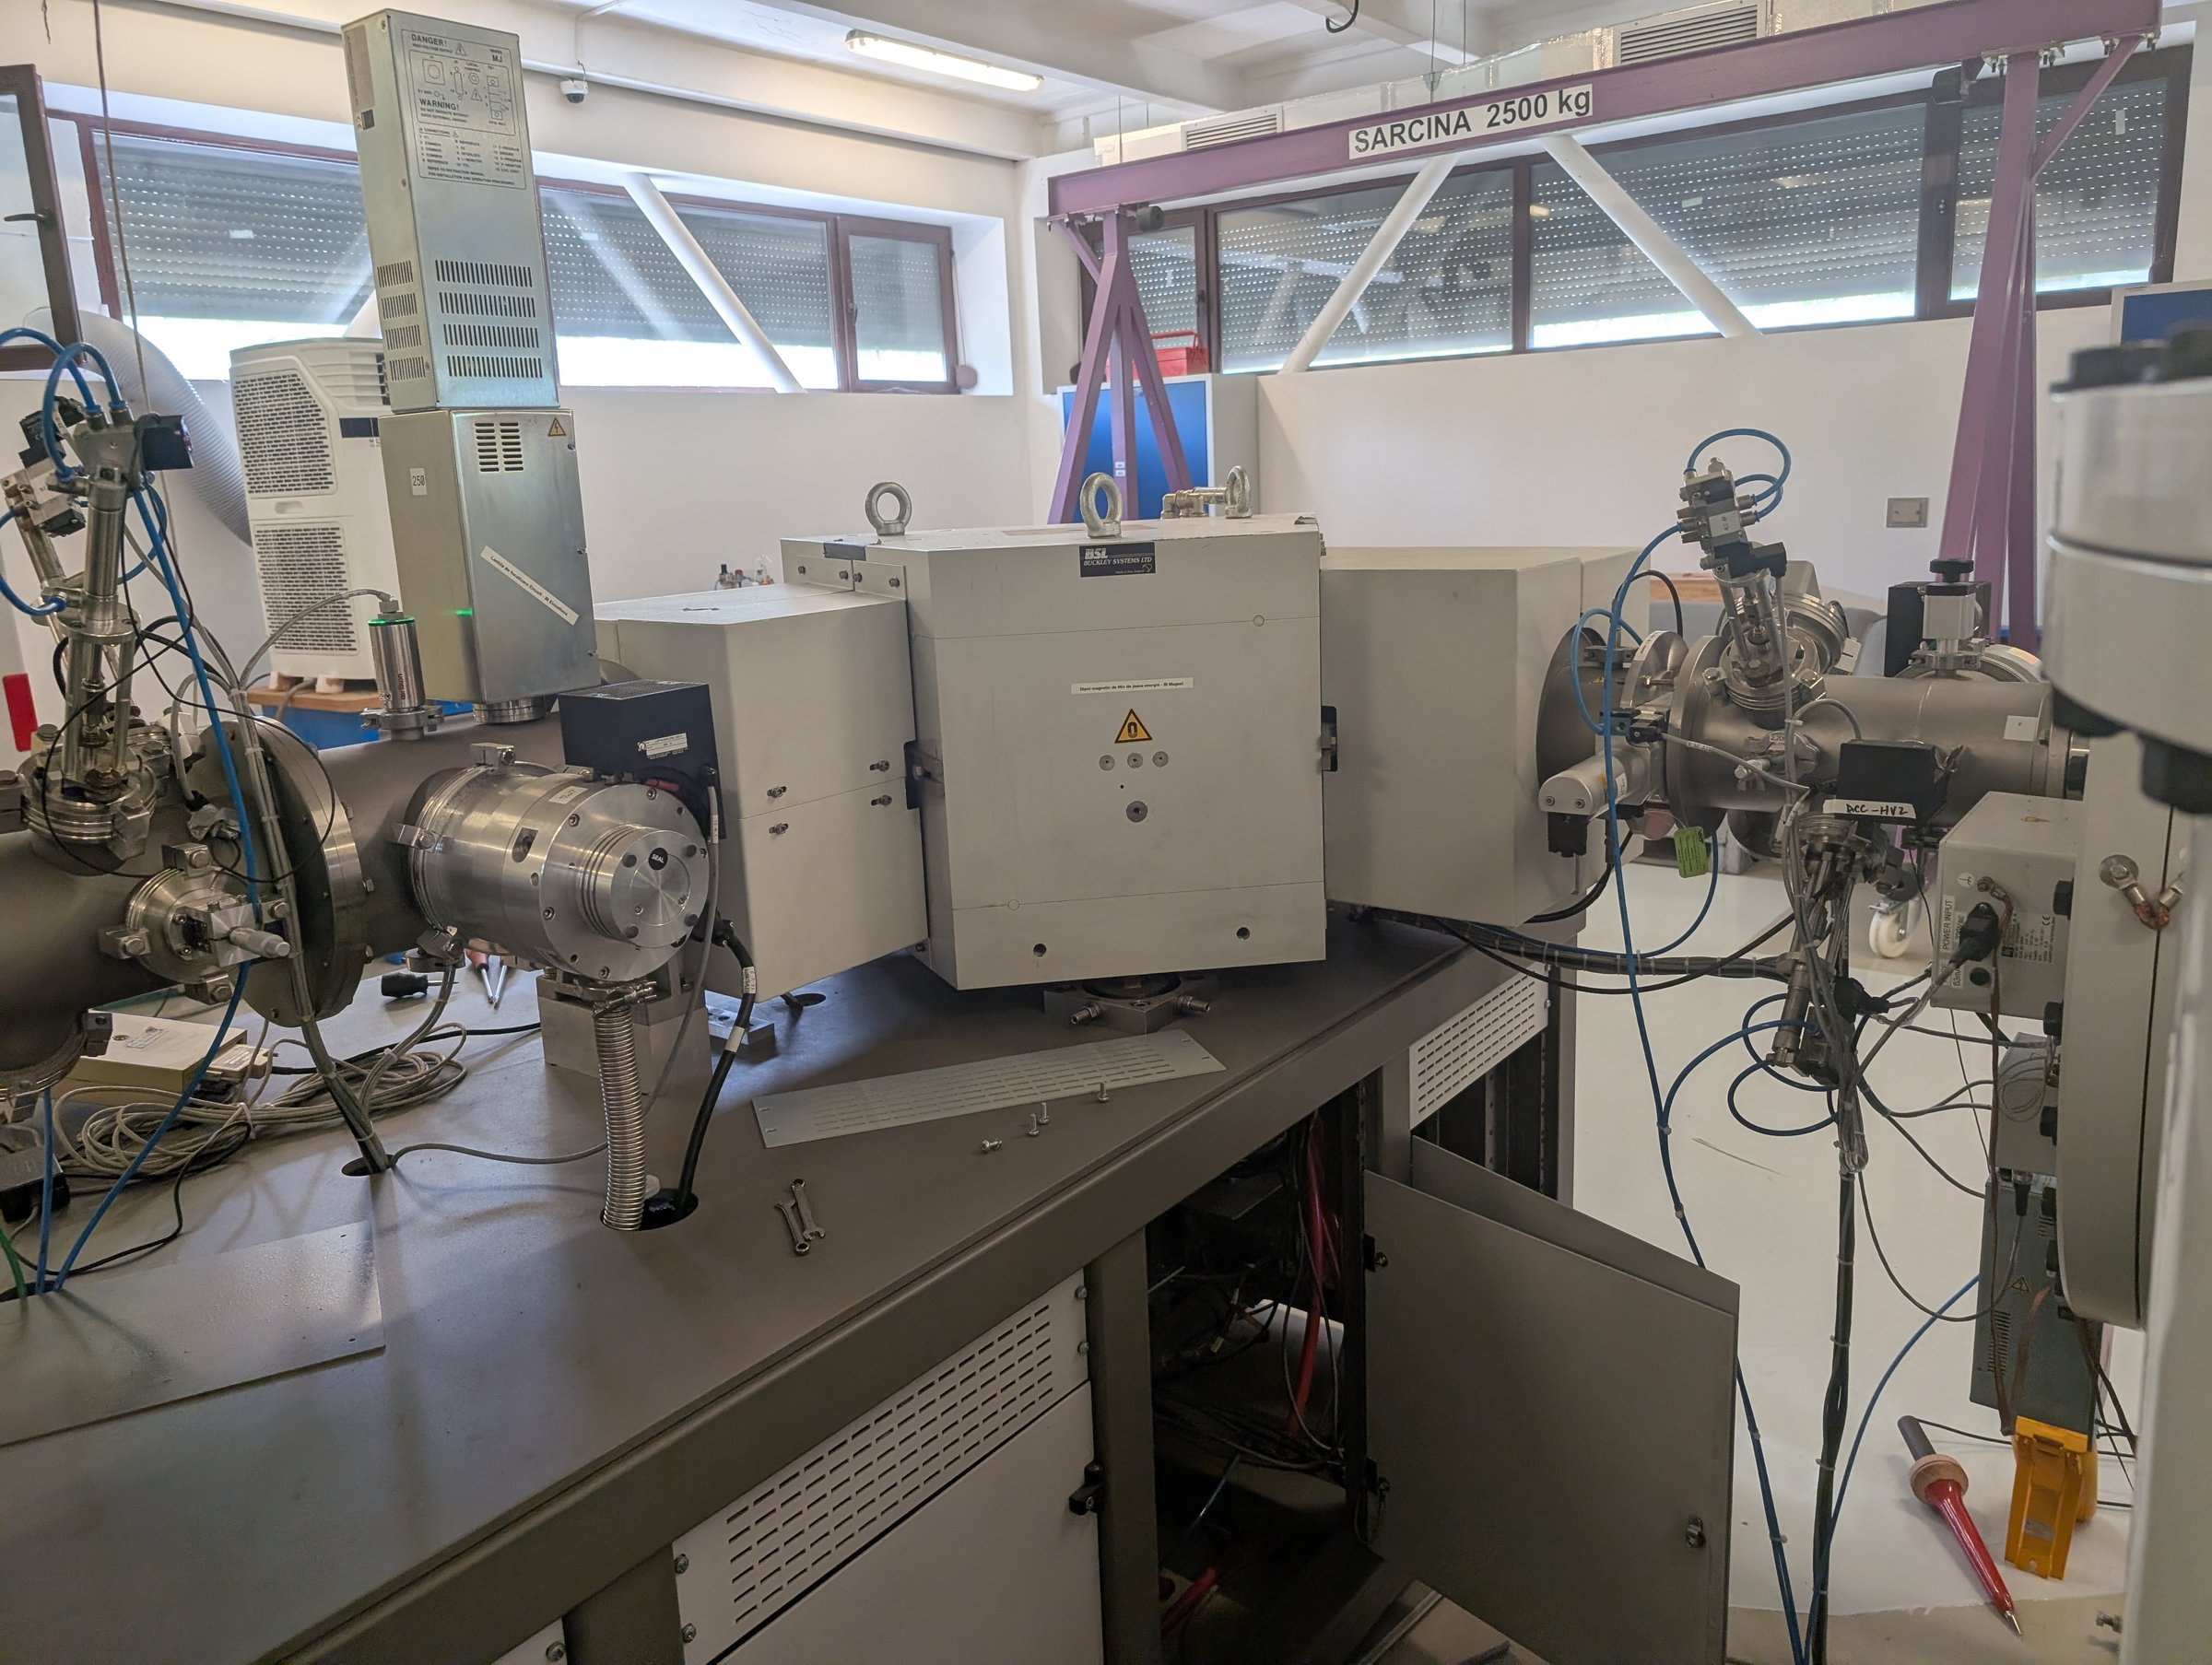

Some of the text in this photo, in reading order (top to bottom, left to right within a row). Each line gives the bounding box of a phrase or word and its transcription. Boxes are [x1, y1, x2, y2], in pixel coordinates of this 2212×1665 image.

[411, 34, 447, 46] DANGER!
[492, 55, 502, 63] MJ
[419, 98, 459, 111] WARNING!
[1354, 89, 1592, 153] SARCINA 2500 kg
[412, 475, 425, 486] 250
[1084, 548, 1108, 560] BSL
[651, 854, 664, 863] SEAL
